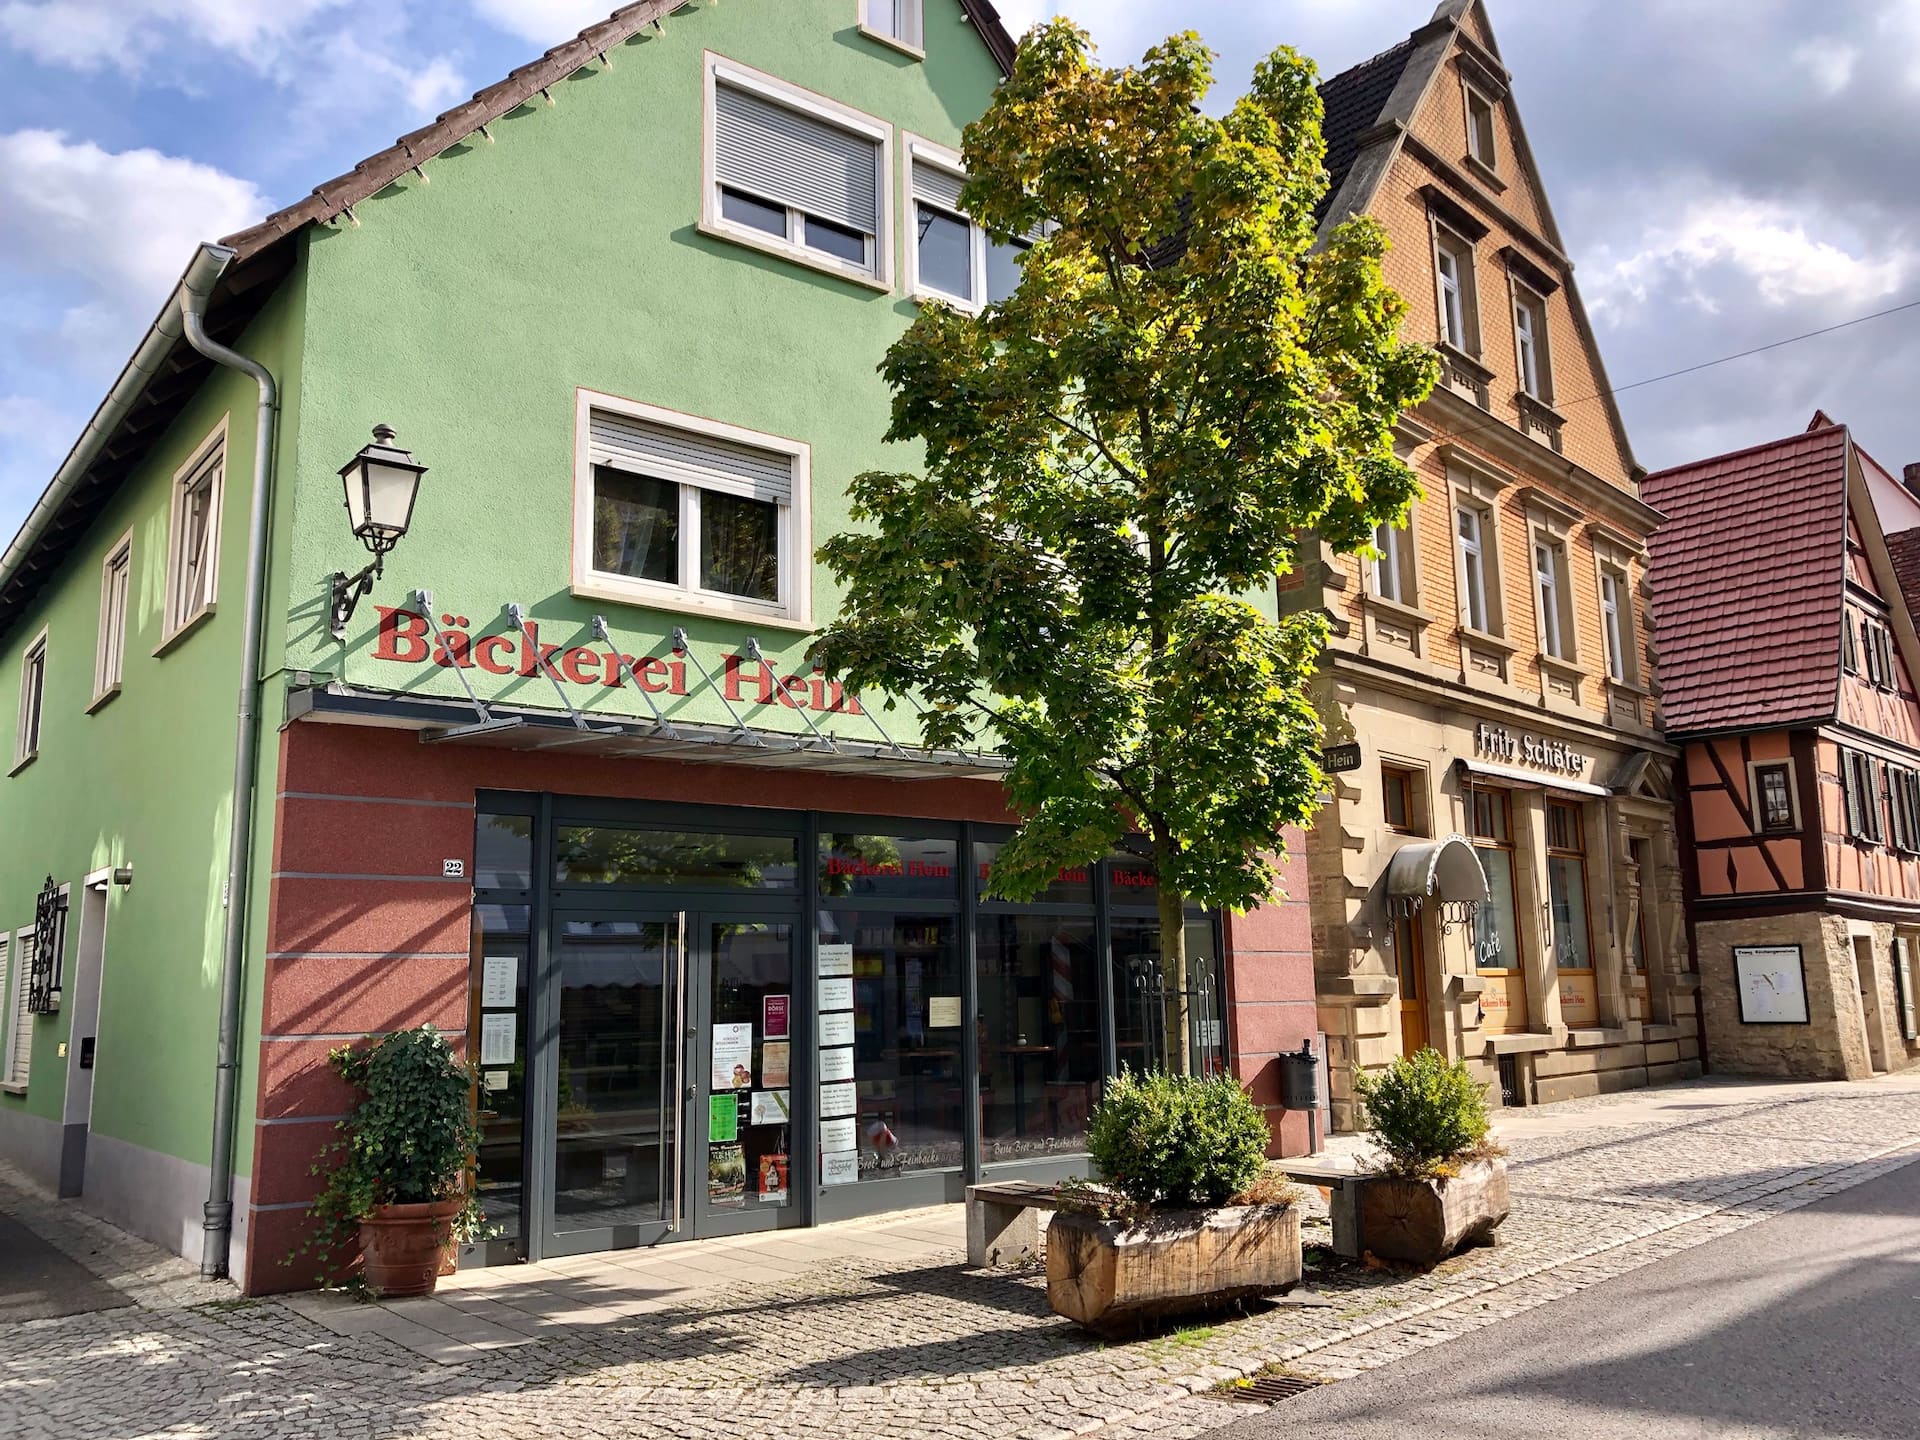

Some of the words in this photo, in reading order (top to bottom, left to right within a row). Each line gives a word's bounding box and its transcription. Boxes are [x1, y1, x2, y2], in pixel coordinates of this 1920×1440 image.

[371, 605, 691, 697] Bäckerei
[720, 652, 865, 716] Hein
[1478, 723, 1518, 757] Fritz
[1523, 735, 1586, 772] Schäfer
[1327, 753, 1354, 769] Hein
[445, 861, 462, 874] 22
[827, 857, 905, 877] Bäckerei
[908, 859, 950, 878] Hein
[1113, 868, 1157, 888] Bäcke
[1479, 931, 1503, 963] Café
[992, 1142, 1012, 1155] Beste
[880, 1154, 894, 1168] und
